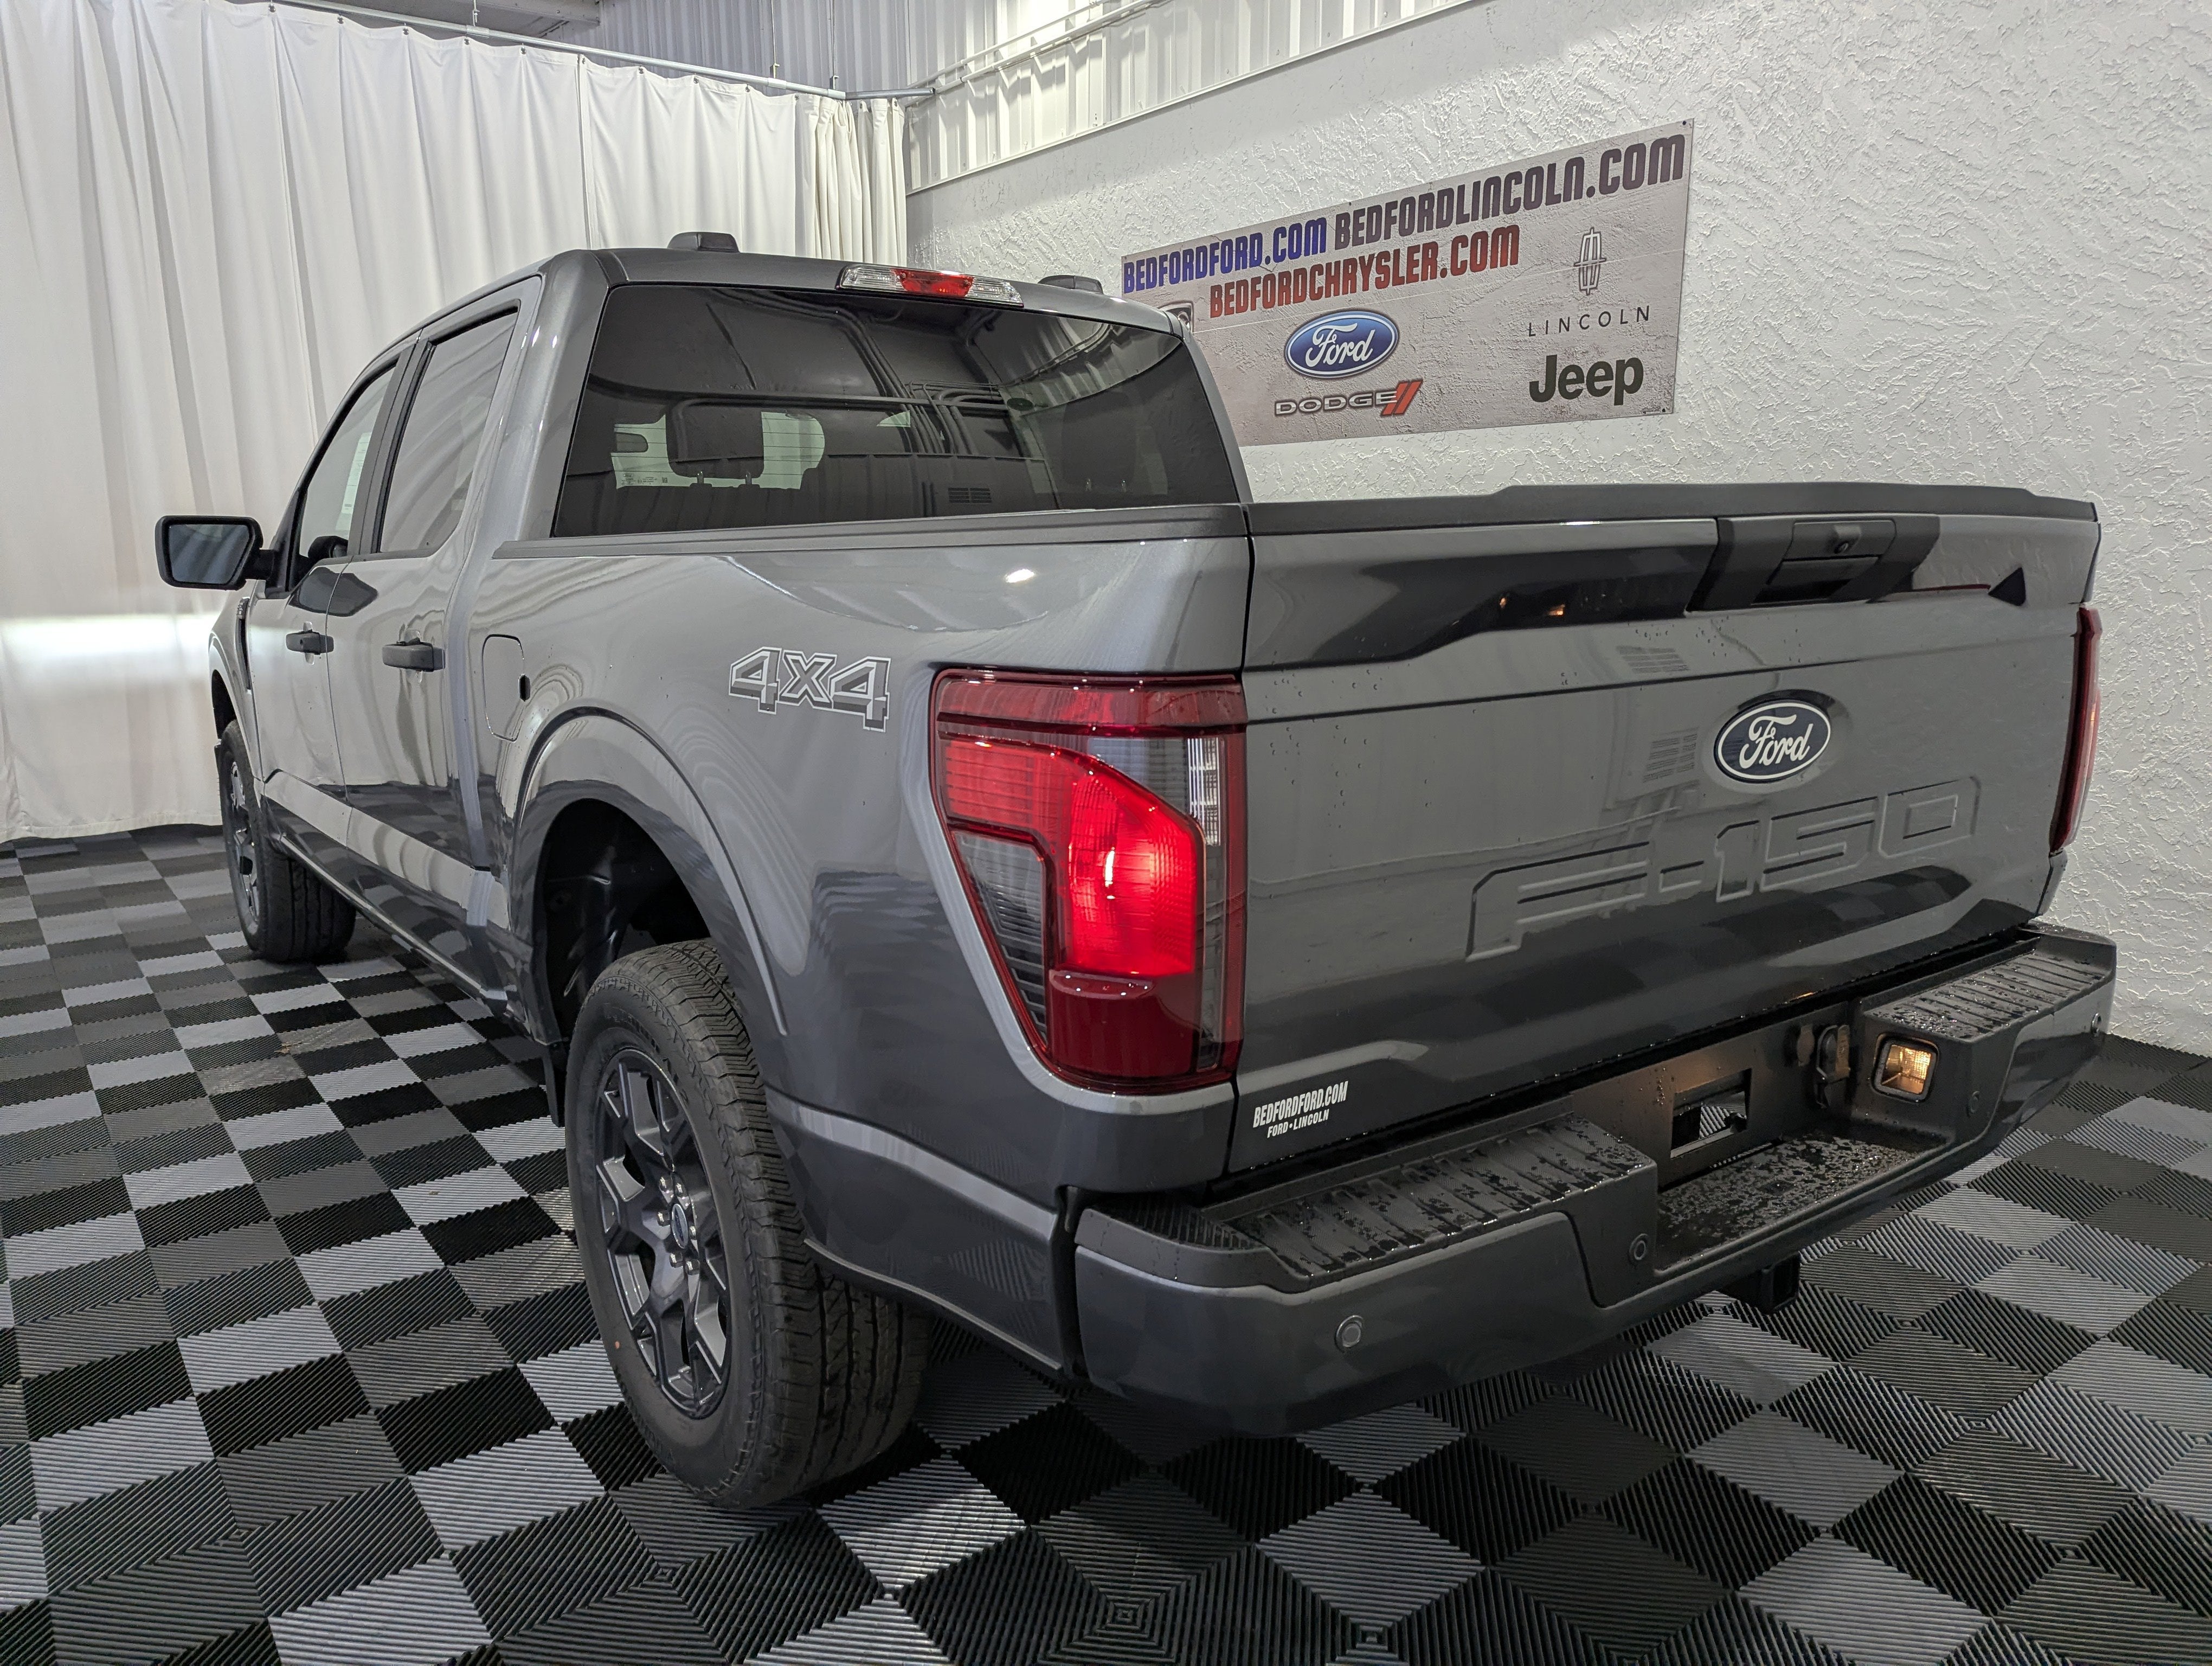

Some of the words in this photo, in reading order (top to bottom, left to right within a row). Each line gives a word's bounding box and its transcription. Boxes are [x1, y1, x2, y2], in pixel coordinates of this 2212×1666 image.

[1123, 217, 1327, 294] BEDFORDFORD.COM
[1335, 134, 1686, 250] BEDFORDLINCOLN.COM
[1210, 224, 1520, 318] BEDFORDCHRYSLER.COM
[1305, 322, 1376, 368] Ford
[1528, 305, 1650, 337] LINCOLN
[1275, 389, 1398, 416] DODGE
[1529, 354, 1644, 406] Jeep
[1739, 714, 1814, 769] Ford
[1465, 776, 1982, 963] F-150
[1252, 1080, 1348, 1129] BEDFORDFORD.COM
